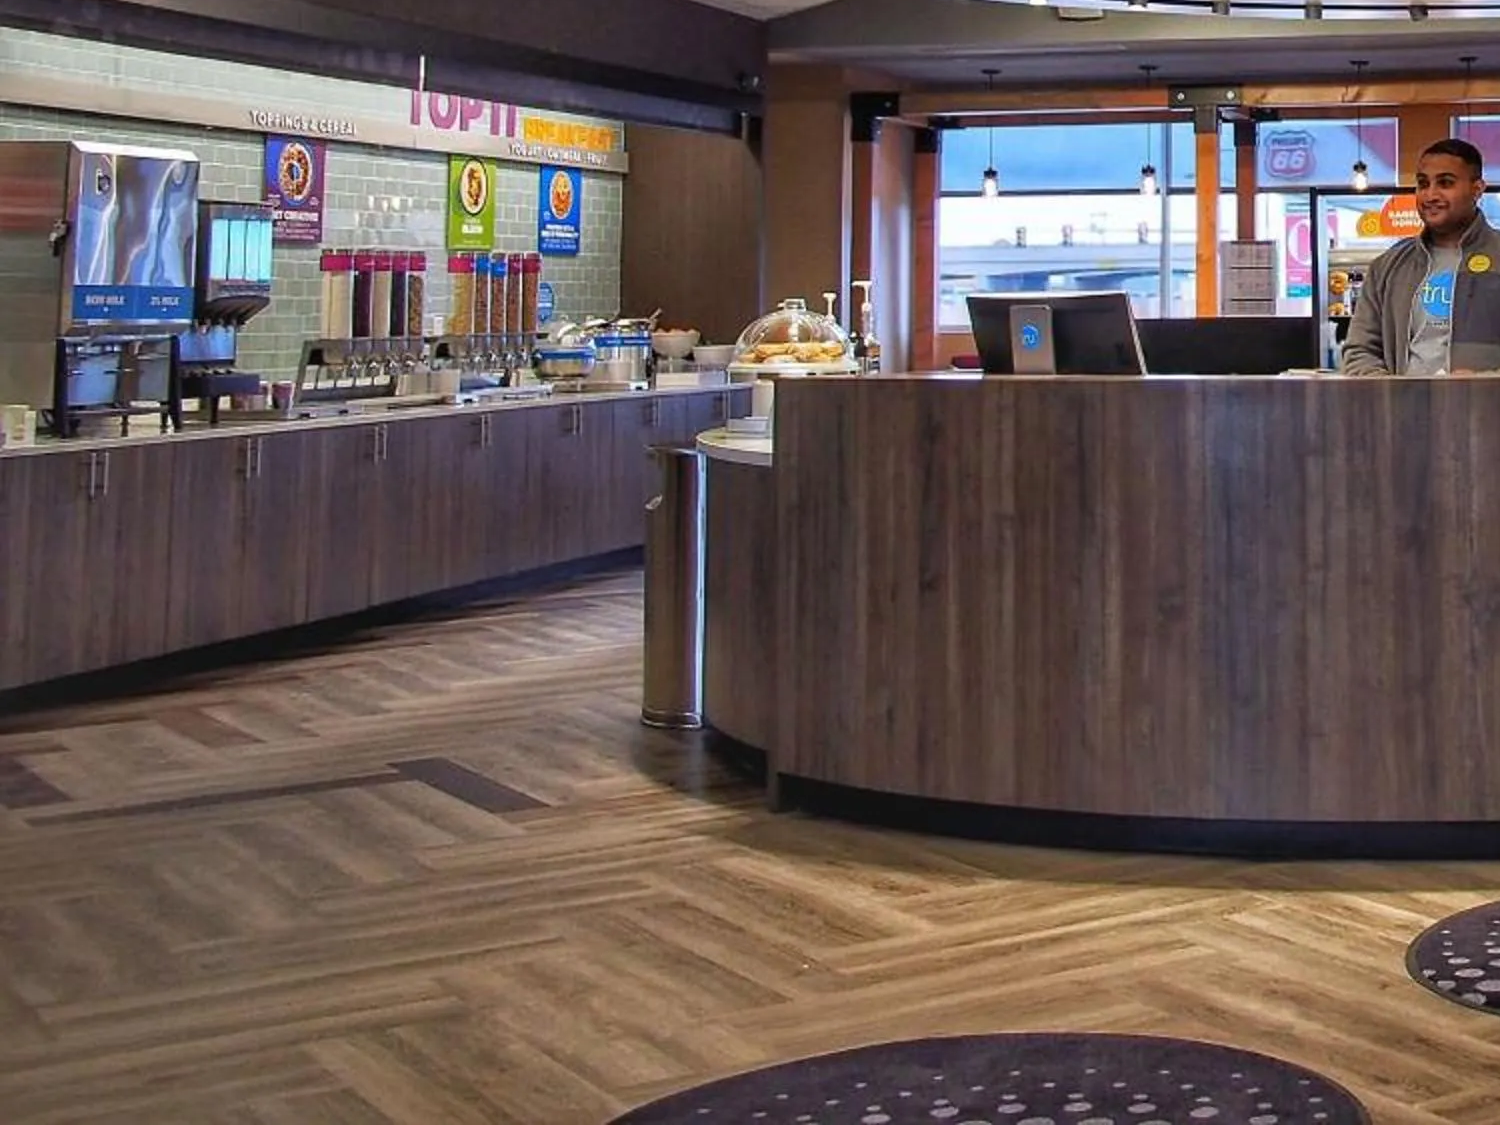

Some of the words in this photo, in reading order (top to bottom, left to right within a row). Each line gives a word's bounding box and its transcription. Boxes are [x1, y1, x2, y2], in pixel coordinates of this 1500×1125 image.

[250, 110, 306, 131] TOPPINGS
[319, 119, 357, 135] CEREAL
[1273, 151, 1306, 170] 66
[1421, 282, 1451, 304] tru
